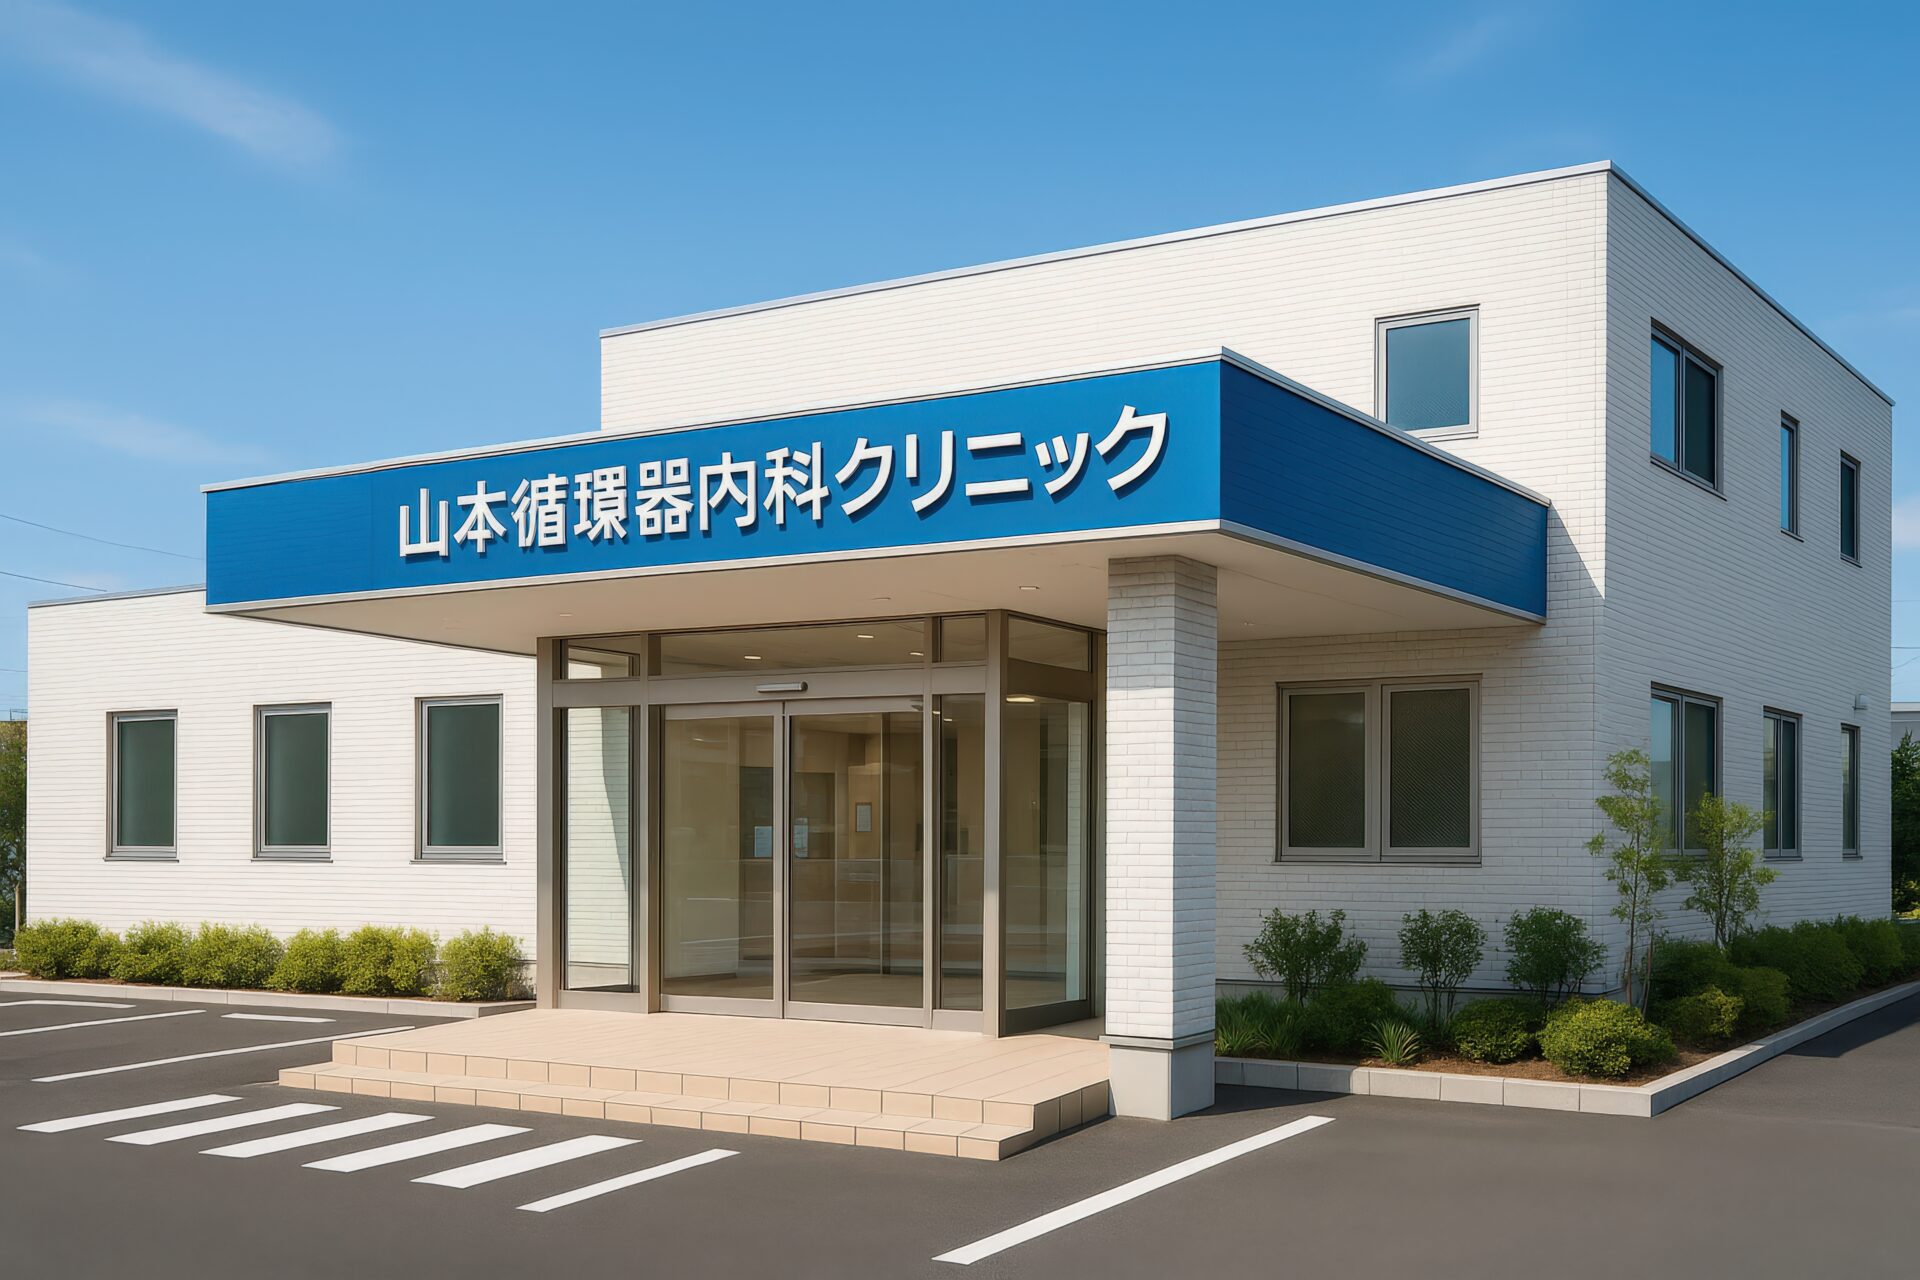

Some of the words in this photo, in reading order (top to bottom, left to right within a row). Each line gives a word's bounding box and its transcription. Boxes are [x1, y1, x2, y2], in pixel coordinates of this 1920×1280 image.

[399, 404, 1167, 558] 山本循環器内科クリニック
